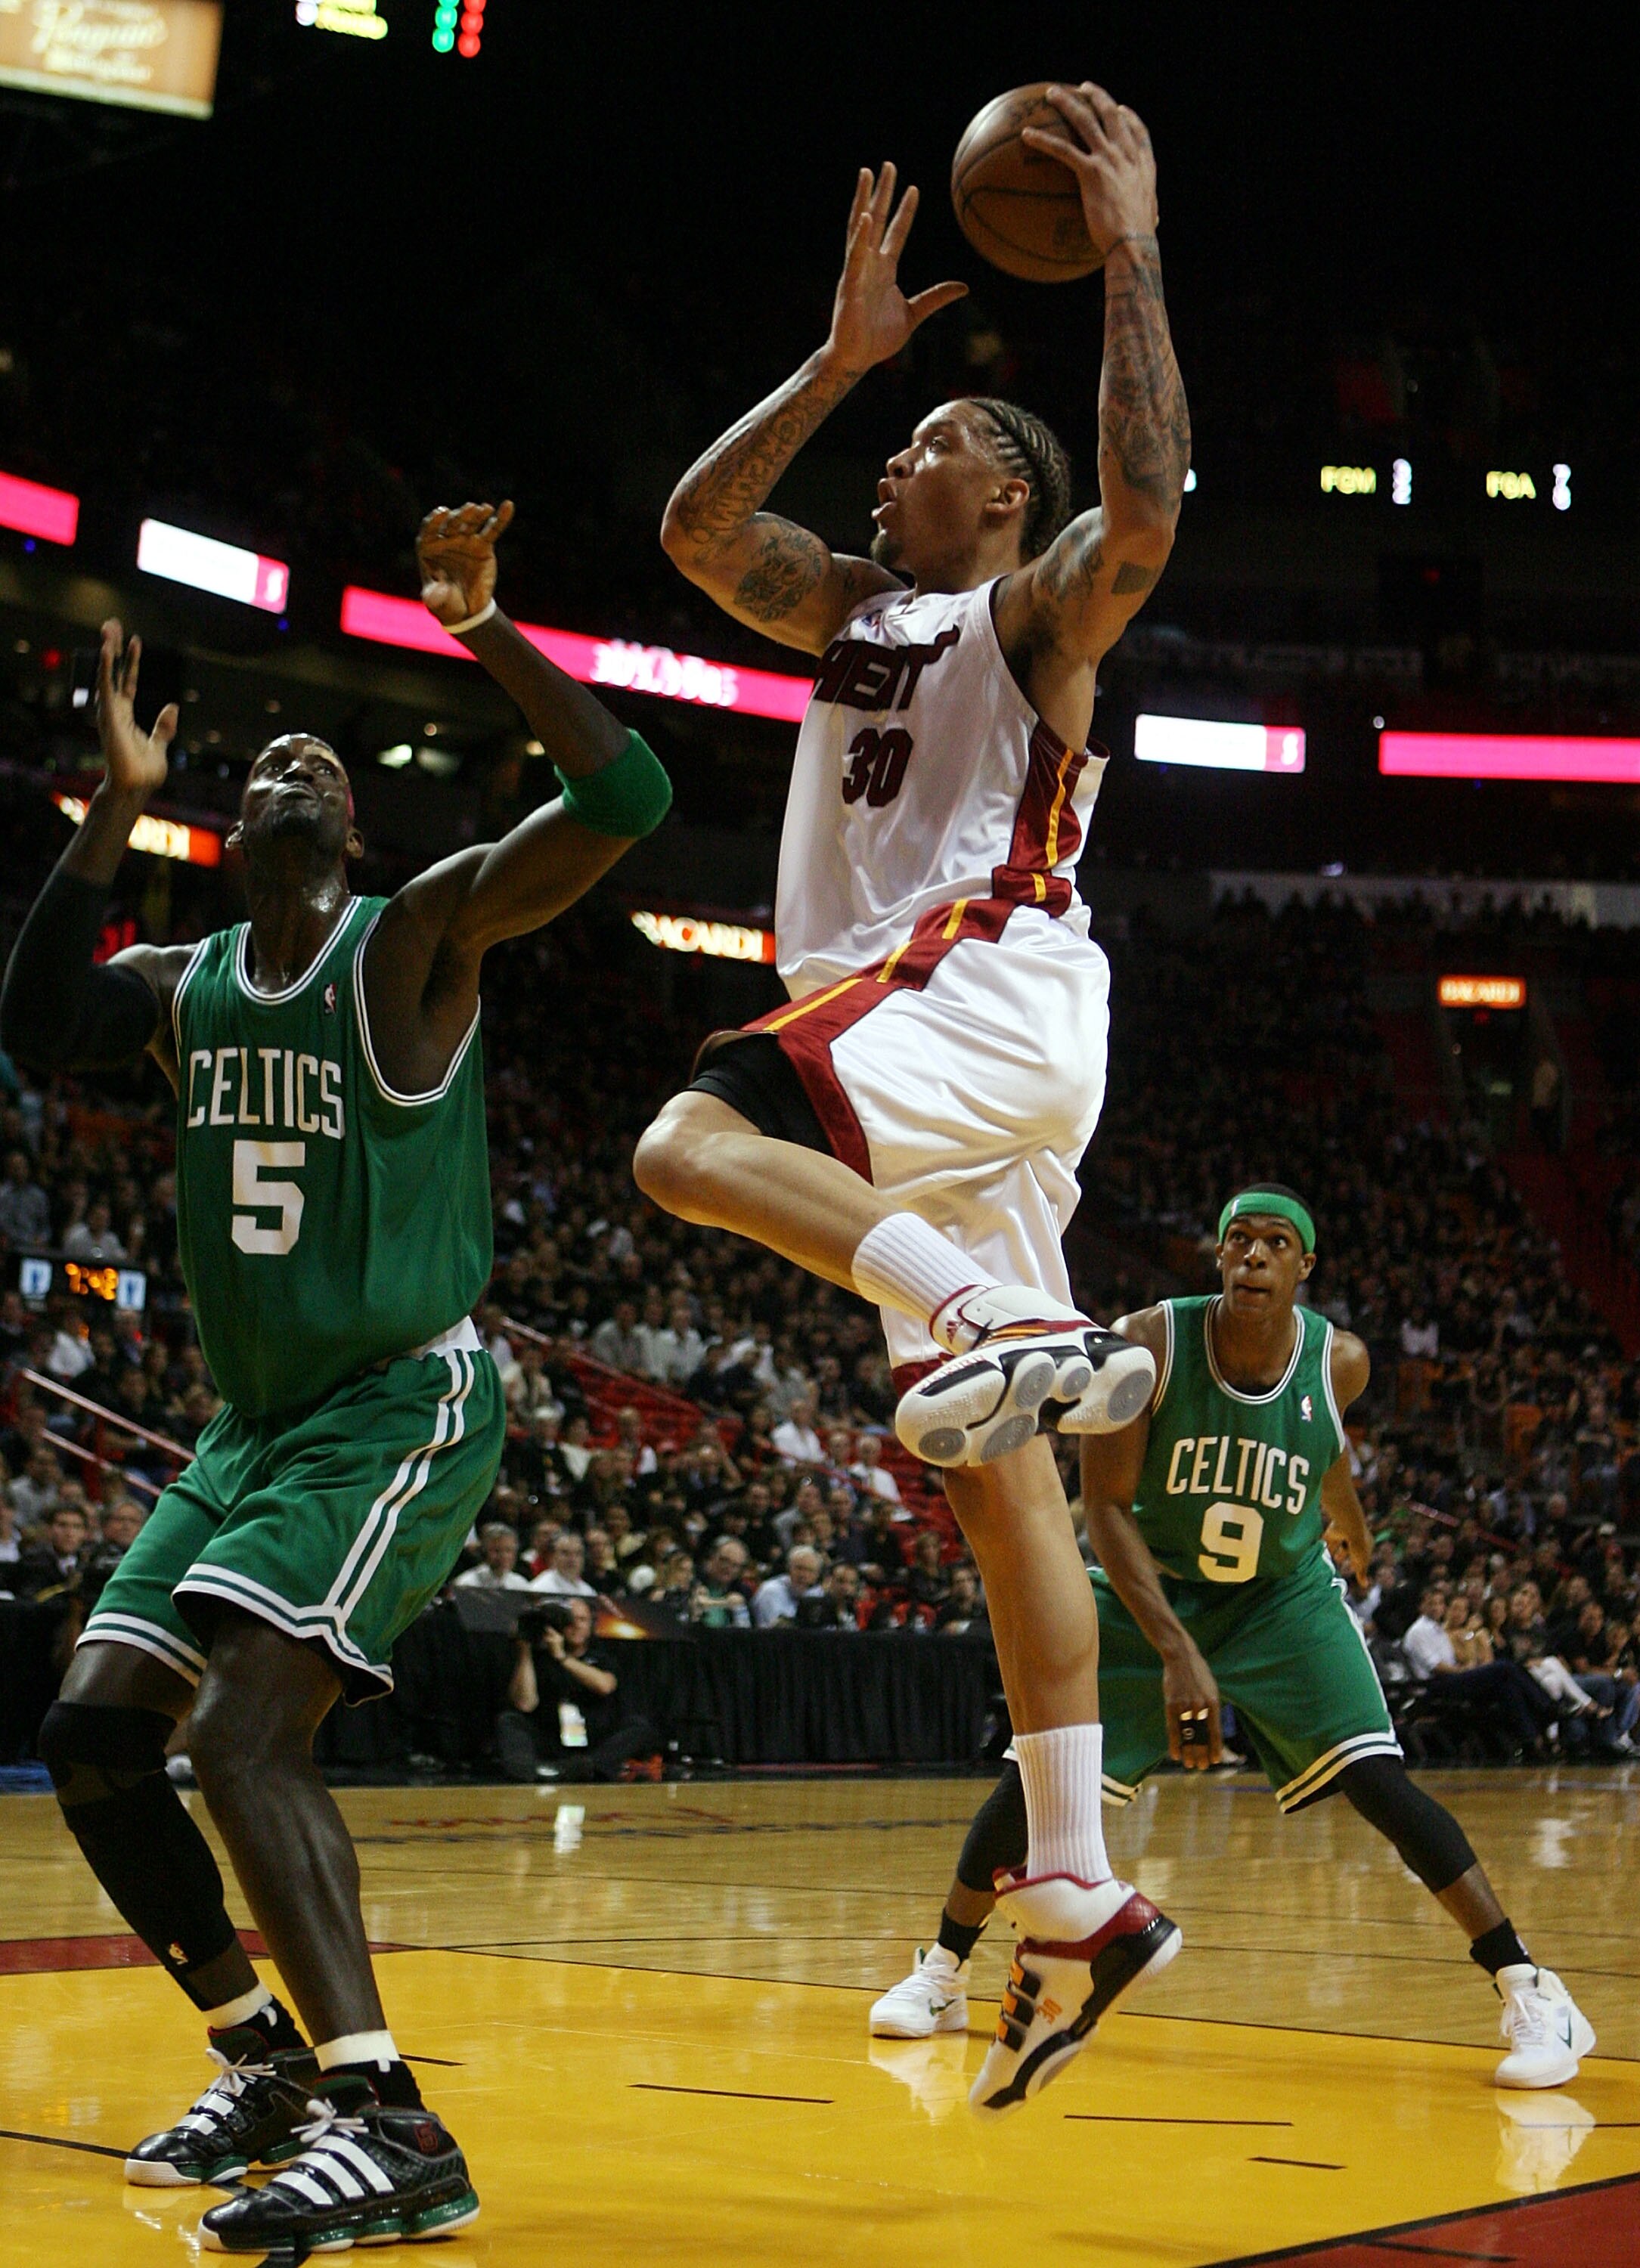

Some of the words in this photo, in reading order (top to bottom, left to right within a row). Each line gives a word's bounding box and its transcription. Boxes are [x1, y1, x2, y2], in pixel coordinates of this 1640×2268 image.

[842, 728, 913, 807] 30
[187, 1047, 346, 1140] CELTICS
[231, 1139, 305, 1255] 5
[1166, 1436, 1310, 1515] CELTICS
[1198, 1501, 1264, 1583] 9
